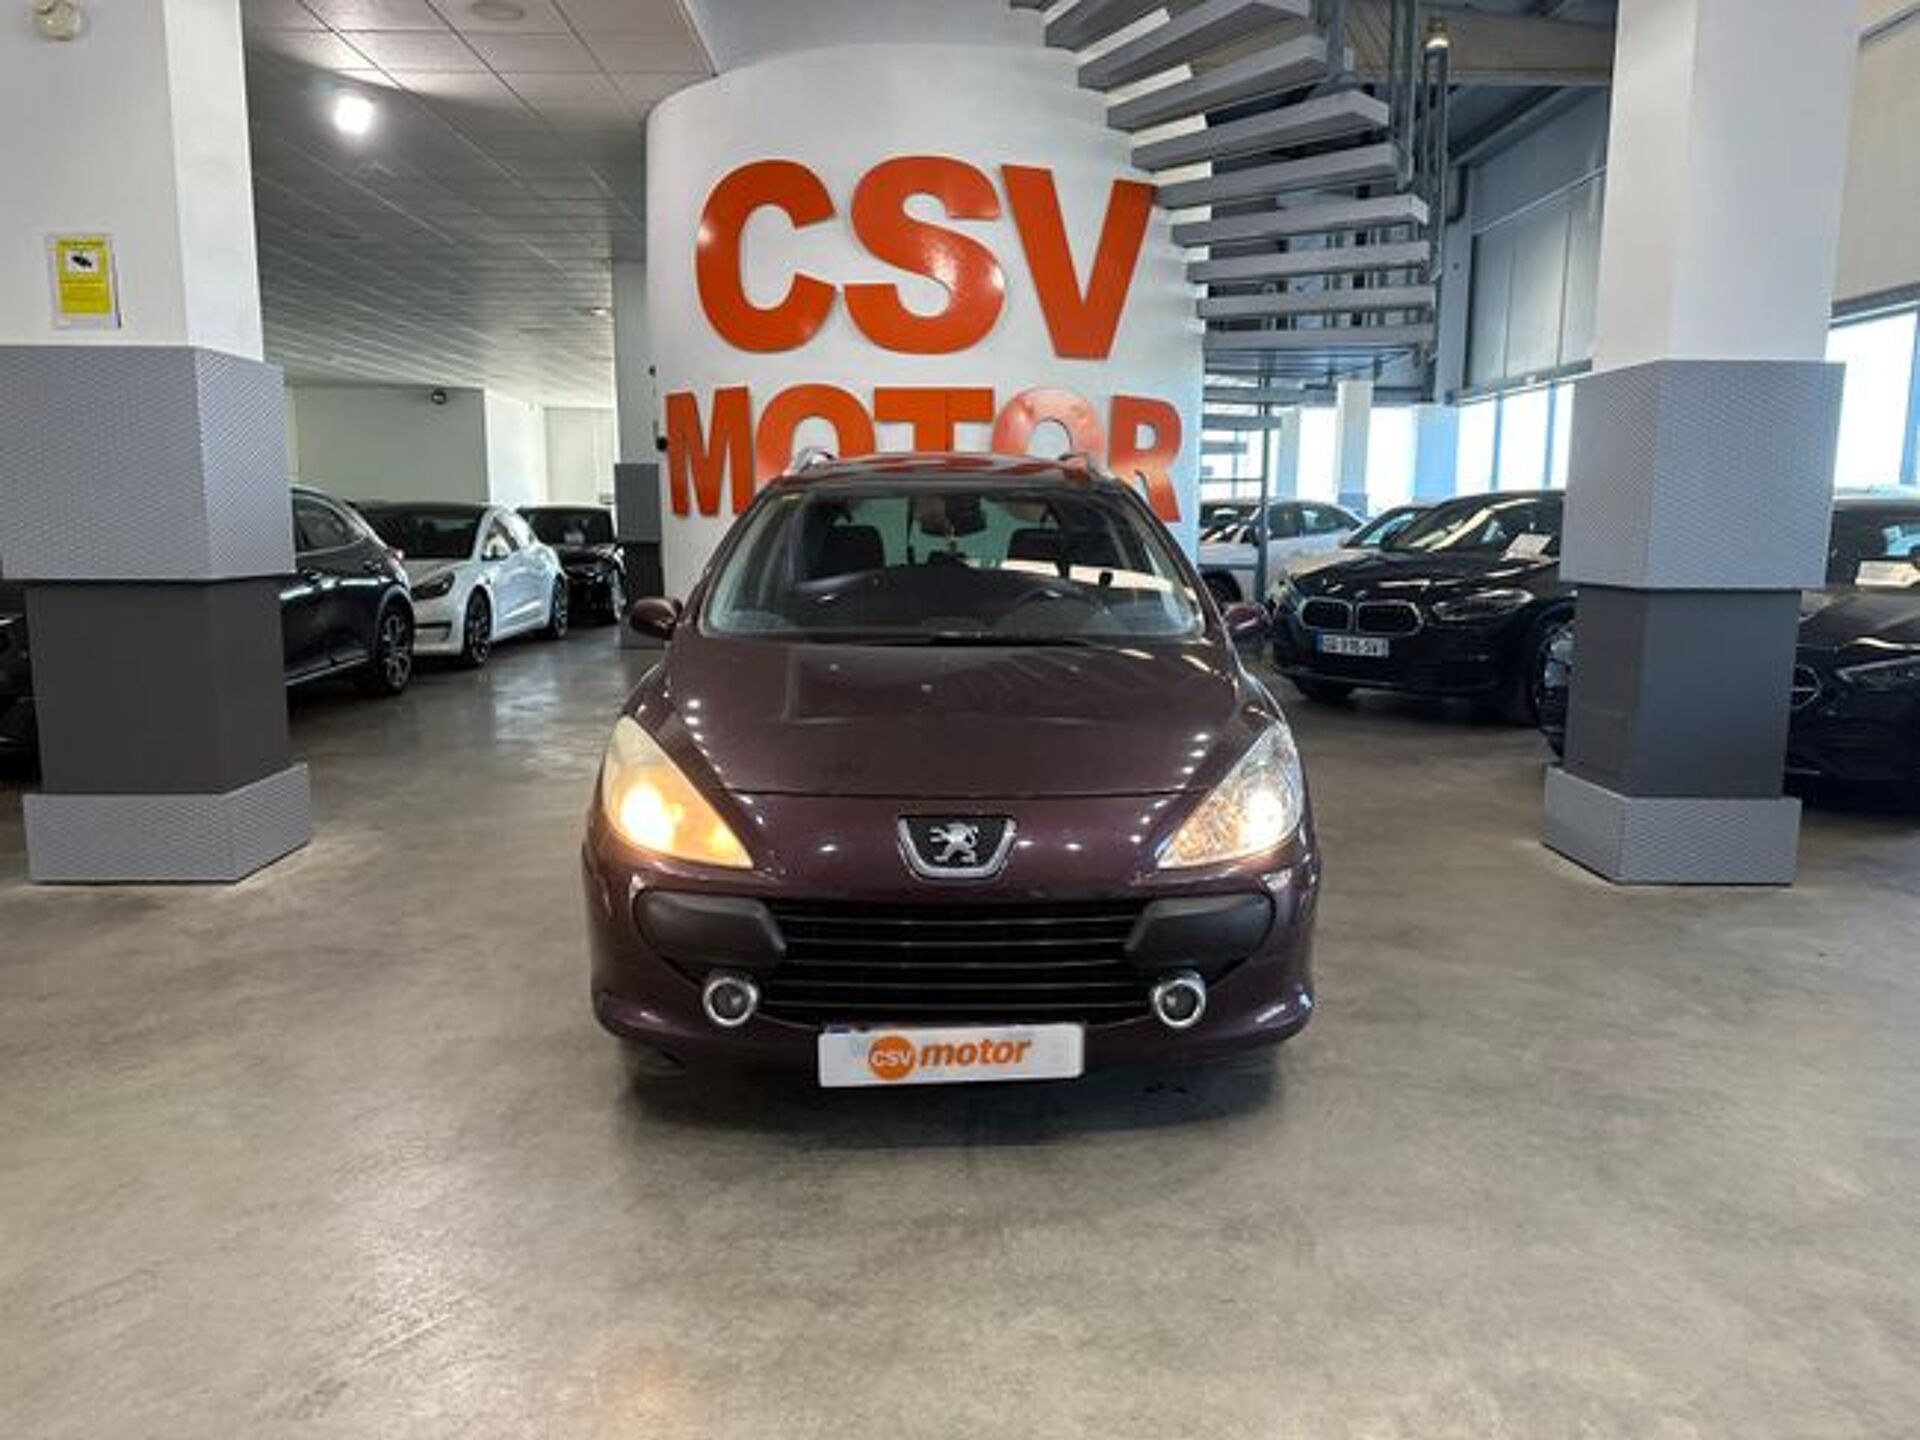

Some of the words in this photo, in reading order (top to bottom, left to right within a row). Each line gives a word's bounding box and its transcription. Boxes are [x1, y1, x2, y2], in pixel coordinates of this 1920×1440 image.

[695, 155, 1156, 360] CSV
[665, 383, 1182, 521] MOTOR
[919, 1038, 1031, 1067] motor
